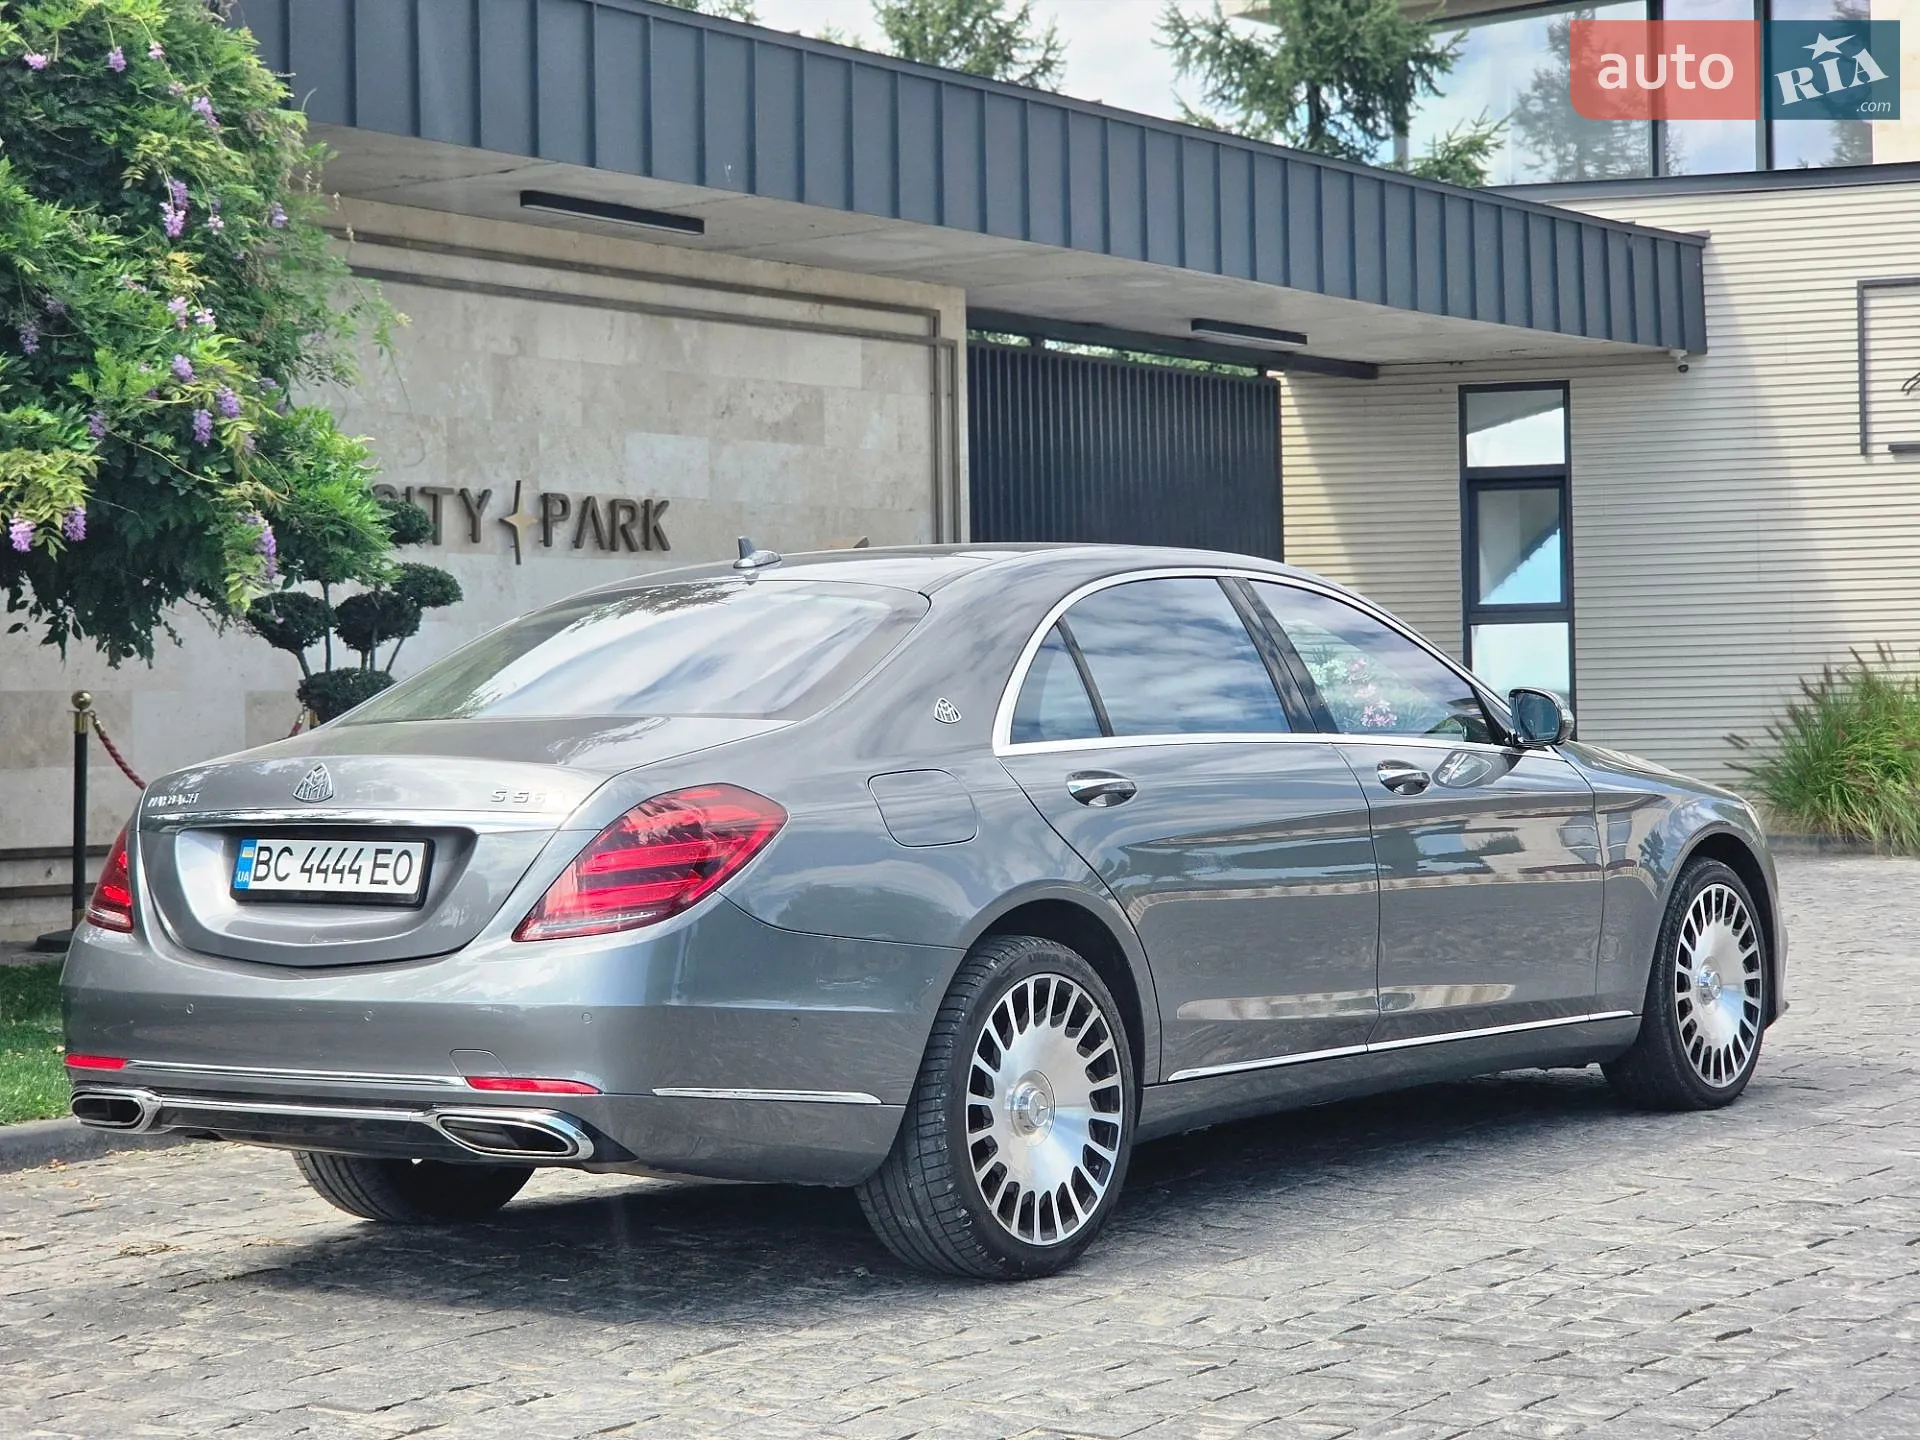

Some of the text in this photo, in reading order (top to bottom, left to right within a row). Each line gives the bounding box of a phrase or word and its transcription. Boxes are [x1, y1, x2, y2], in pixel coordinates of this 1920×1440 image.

[372, 484, 671, 552] TY PARK
[490, 790, 508, 803] S
[237, 871, 250, 884] UA
[252, 845, 414, 886] BC 4444 EO
